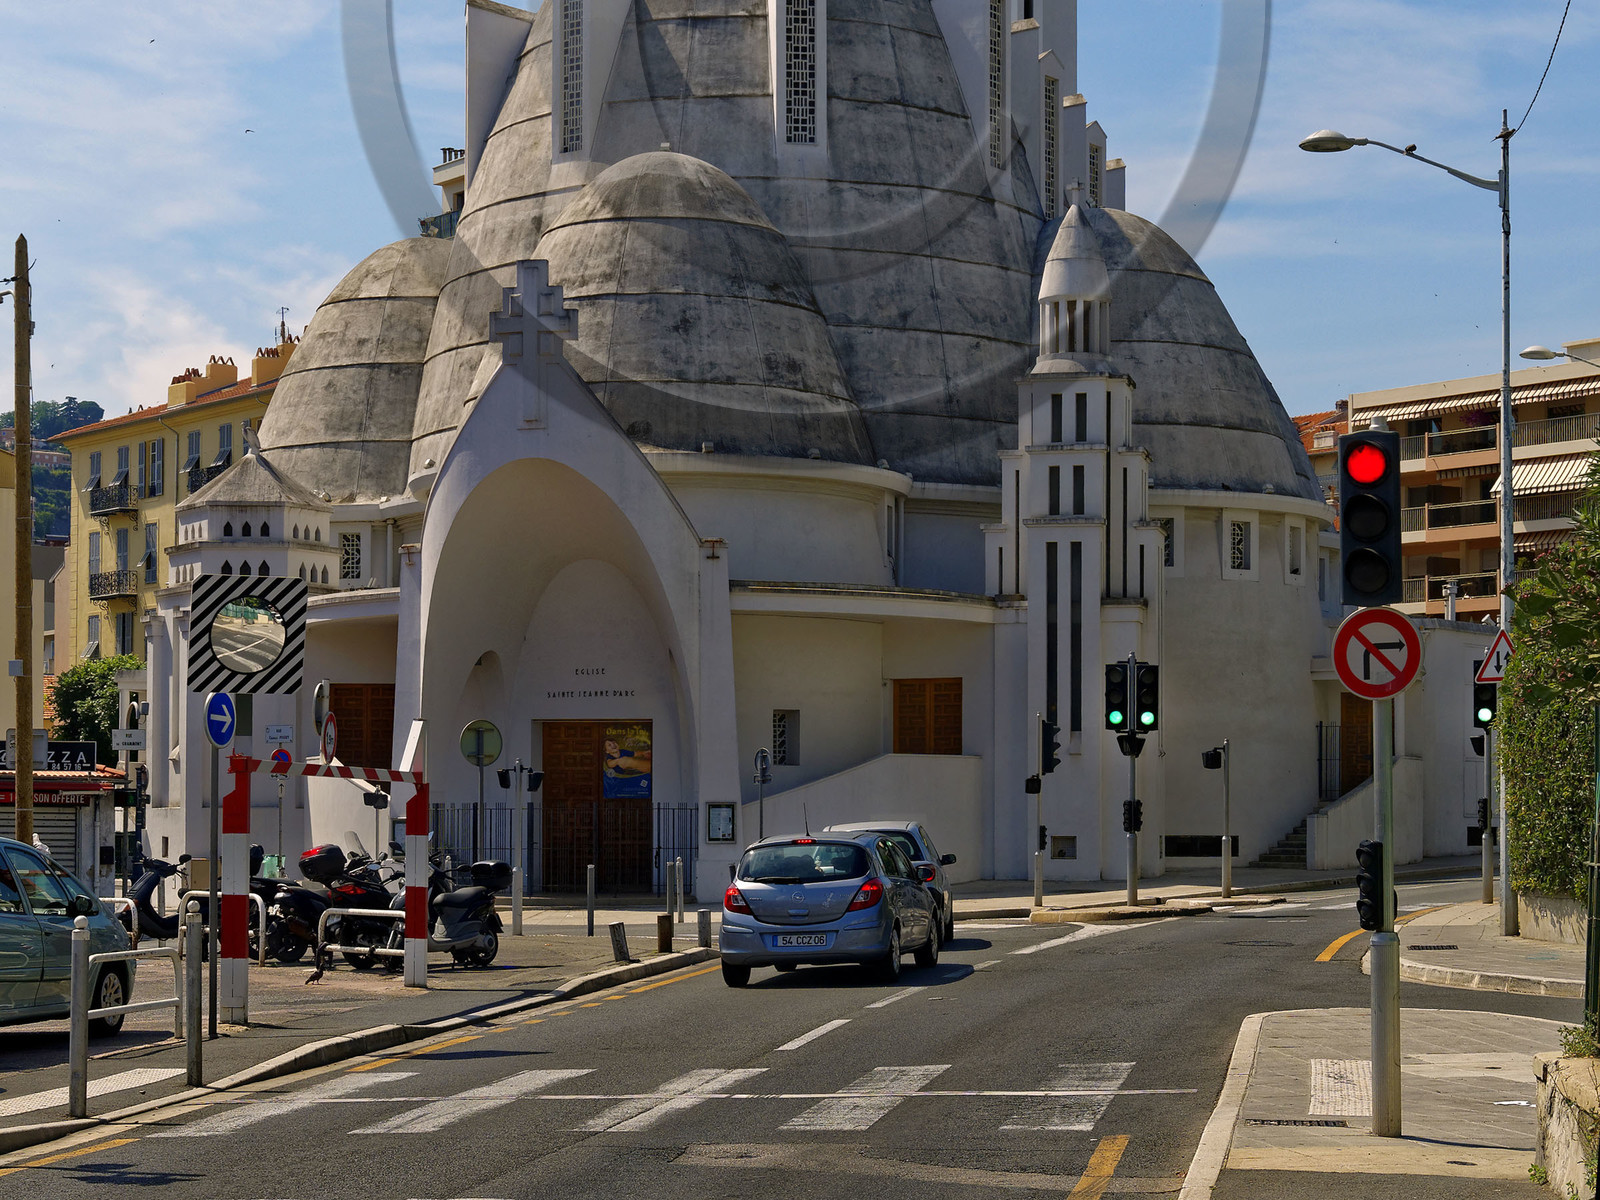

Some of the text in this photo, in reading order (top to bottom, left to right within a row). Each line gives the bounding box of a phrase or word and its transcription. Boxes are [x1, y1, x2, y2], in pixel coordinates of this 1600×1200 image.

[575, 668, 606, 676] EGLISE
[547, 691, 574, 699] SAINTE
[578, 690, 609, 698] JEANNE
[51, 793, 85, 804] OFFERTE
[781, 935, 825, 945] 54 CCZ 06
